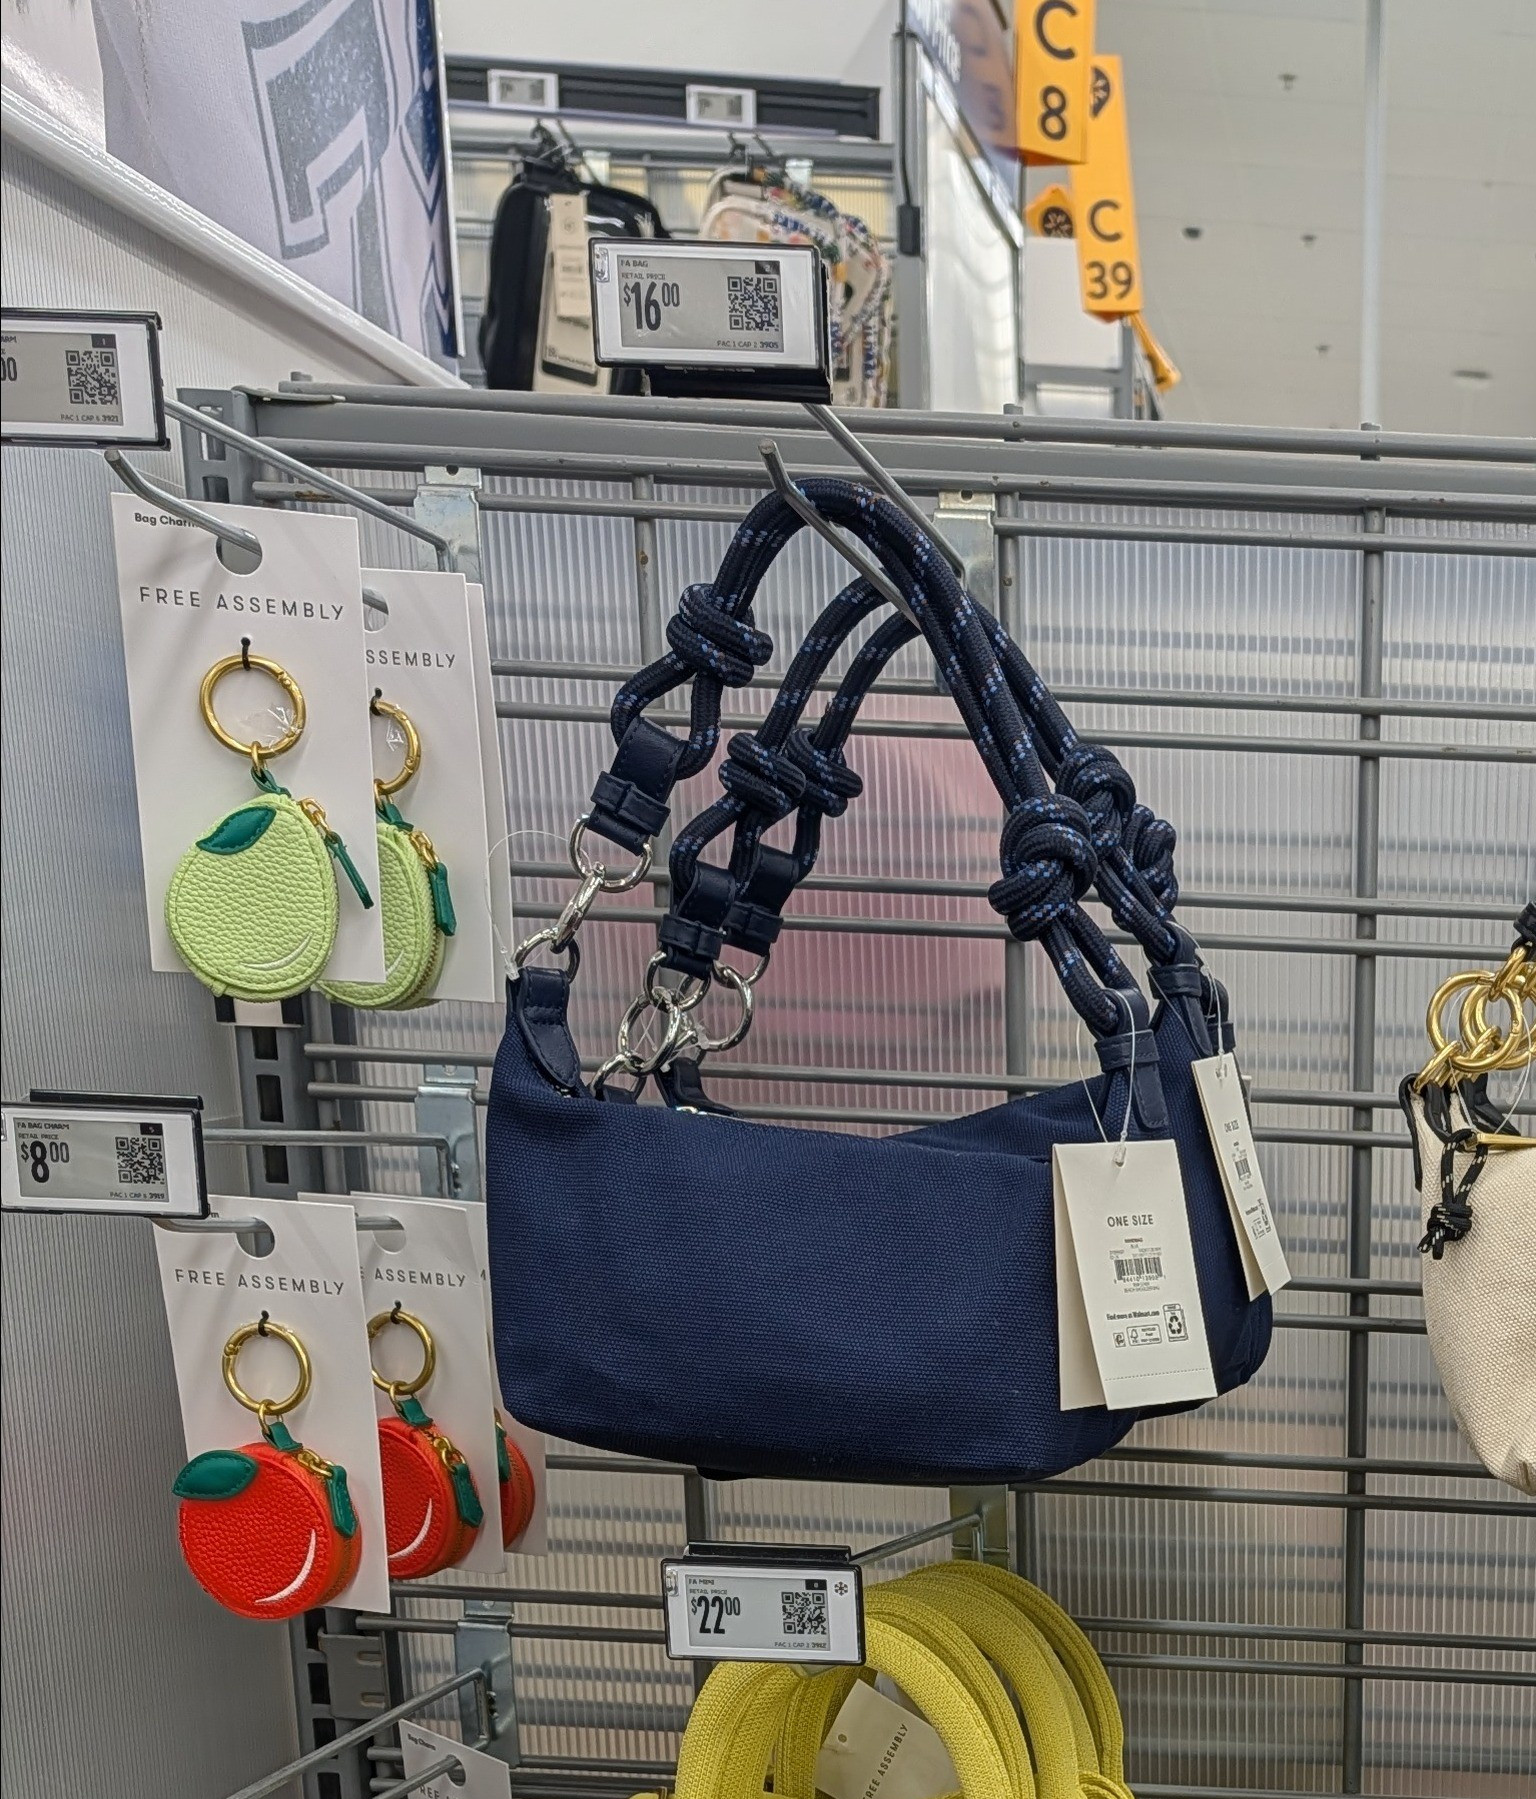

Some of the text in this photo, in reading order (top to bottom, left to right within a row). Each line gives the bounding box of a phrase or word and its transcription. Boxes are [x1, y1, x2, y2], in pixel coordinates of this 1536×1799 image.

[1034, 0, 1078, 60] C
[1038, 85, 1067, 141] 8
[1088, 200, 1123, 243] C
[1085, 260, 1133, 301] 39
[134, 512, 157, 528] Bag
[139, 586, 345, 621] FREE ASSEMBLY
[365, 649, 456, 668] SSEMBLY
[1107, 1213, 1154, 1228] ONE SIZE
[174, 1268, 226, 1287] FREE
[237, 1273, 345, 1297] ASSEMBLY
[374, 1267, 466, 1287] ASSEMBLY
[877, 1723, 909, 1777] ASSEMBLY
